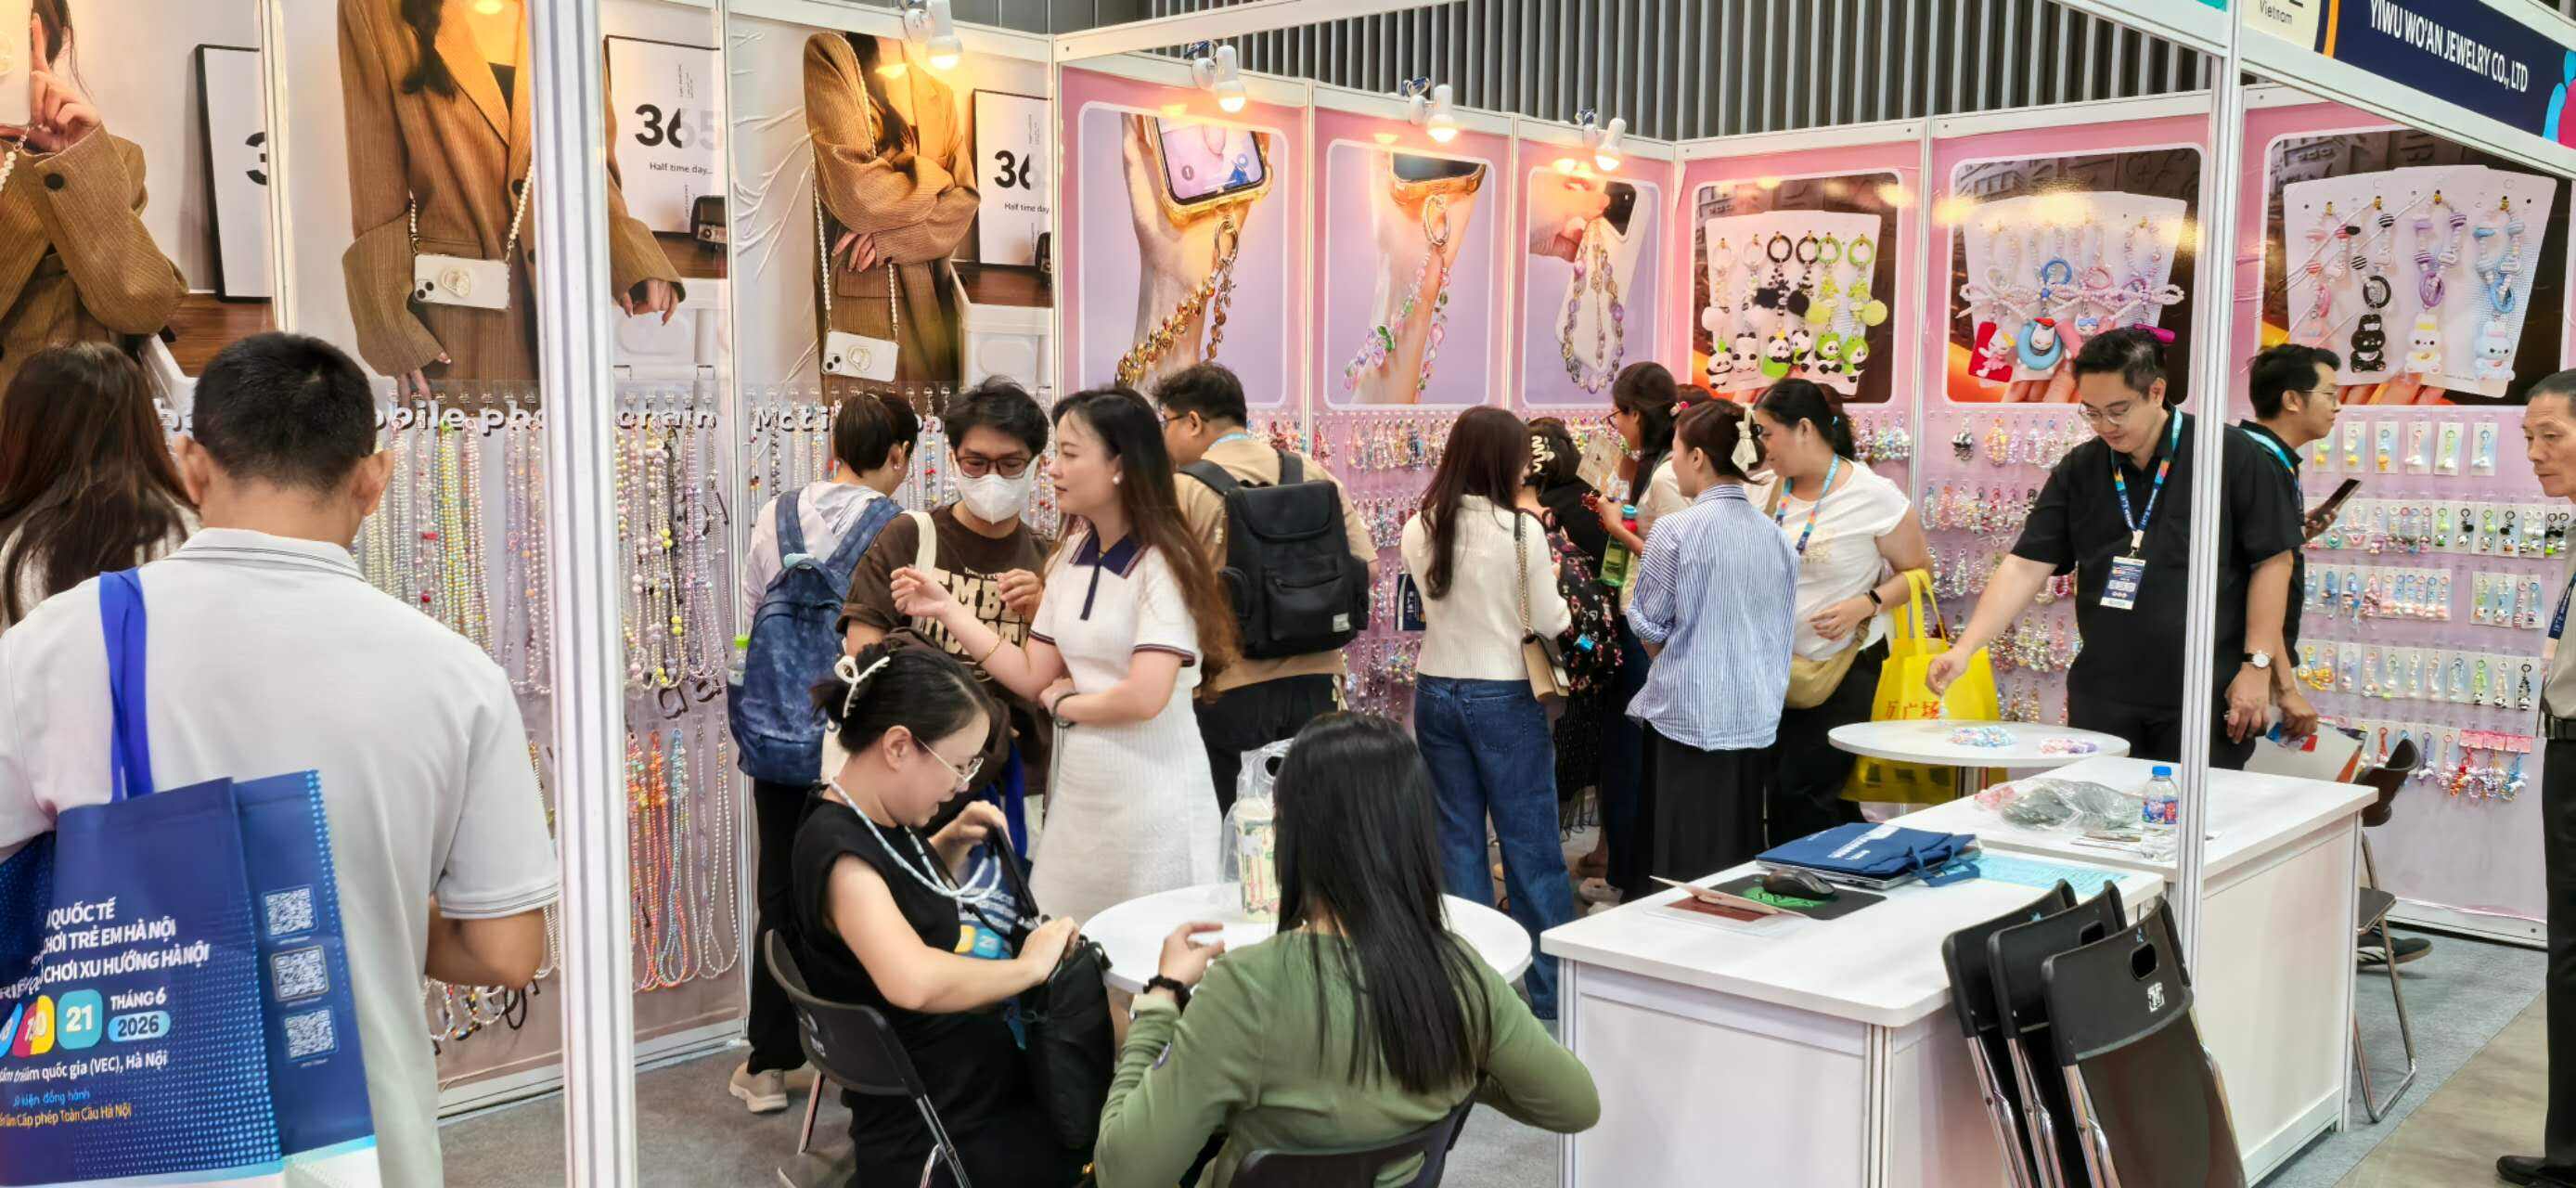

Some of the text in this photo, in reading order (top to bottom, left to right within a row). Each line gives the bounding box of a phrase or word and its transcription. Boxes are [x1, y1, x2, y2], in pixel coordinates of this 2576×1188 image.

[2260, 0, 2292, 24] Vietnam
[2370, 0, 2403, 38] YIWU
[2404, 9, 2443, 57] WO'AN
[2443, 30, 2491, 76] JEWELRY
[2511, 60, 2528, 92] LTD
[650, 161, 669, 172] Half
[670, 162, 689, 174] time
[1005, 202, 1019, 212] Half
[1021, 203, 1036, 213] time
[51, 896, 117, 930] QUỐC TẾ
[69, 924, 100, 950] TRẺ
[101, 926, 122, 947] EM
[123, 918, 147, 943] HÀ
[148, 915, 176, 943] NỘI
[45, 959, 77, 984] CHƠI
[80, 959, 101, 979] XU
[161, 943, 184, 968] HÀ
[183, 939, 211, 968] NỘI
[110, 986, 167, 1012] THÁNG 6
[66, 1003, 93, 1033] 21
[118, 1014, 160, 1038] 2026
[42, 1061, 68, 1081] quốc
[70, 1060, 87, 1080] gia
[90, 1055, 124, 1077] (VEC),
[125, 1051, 143, 1070] Hà
[145, 1049, 168, 1070] Nội
